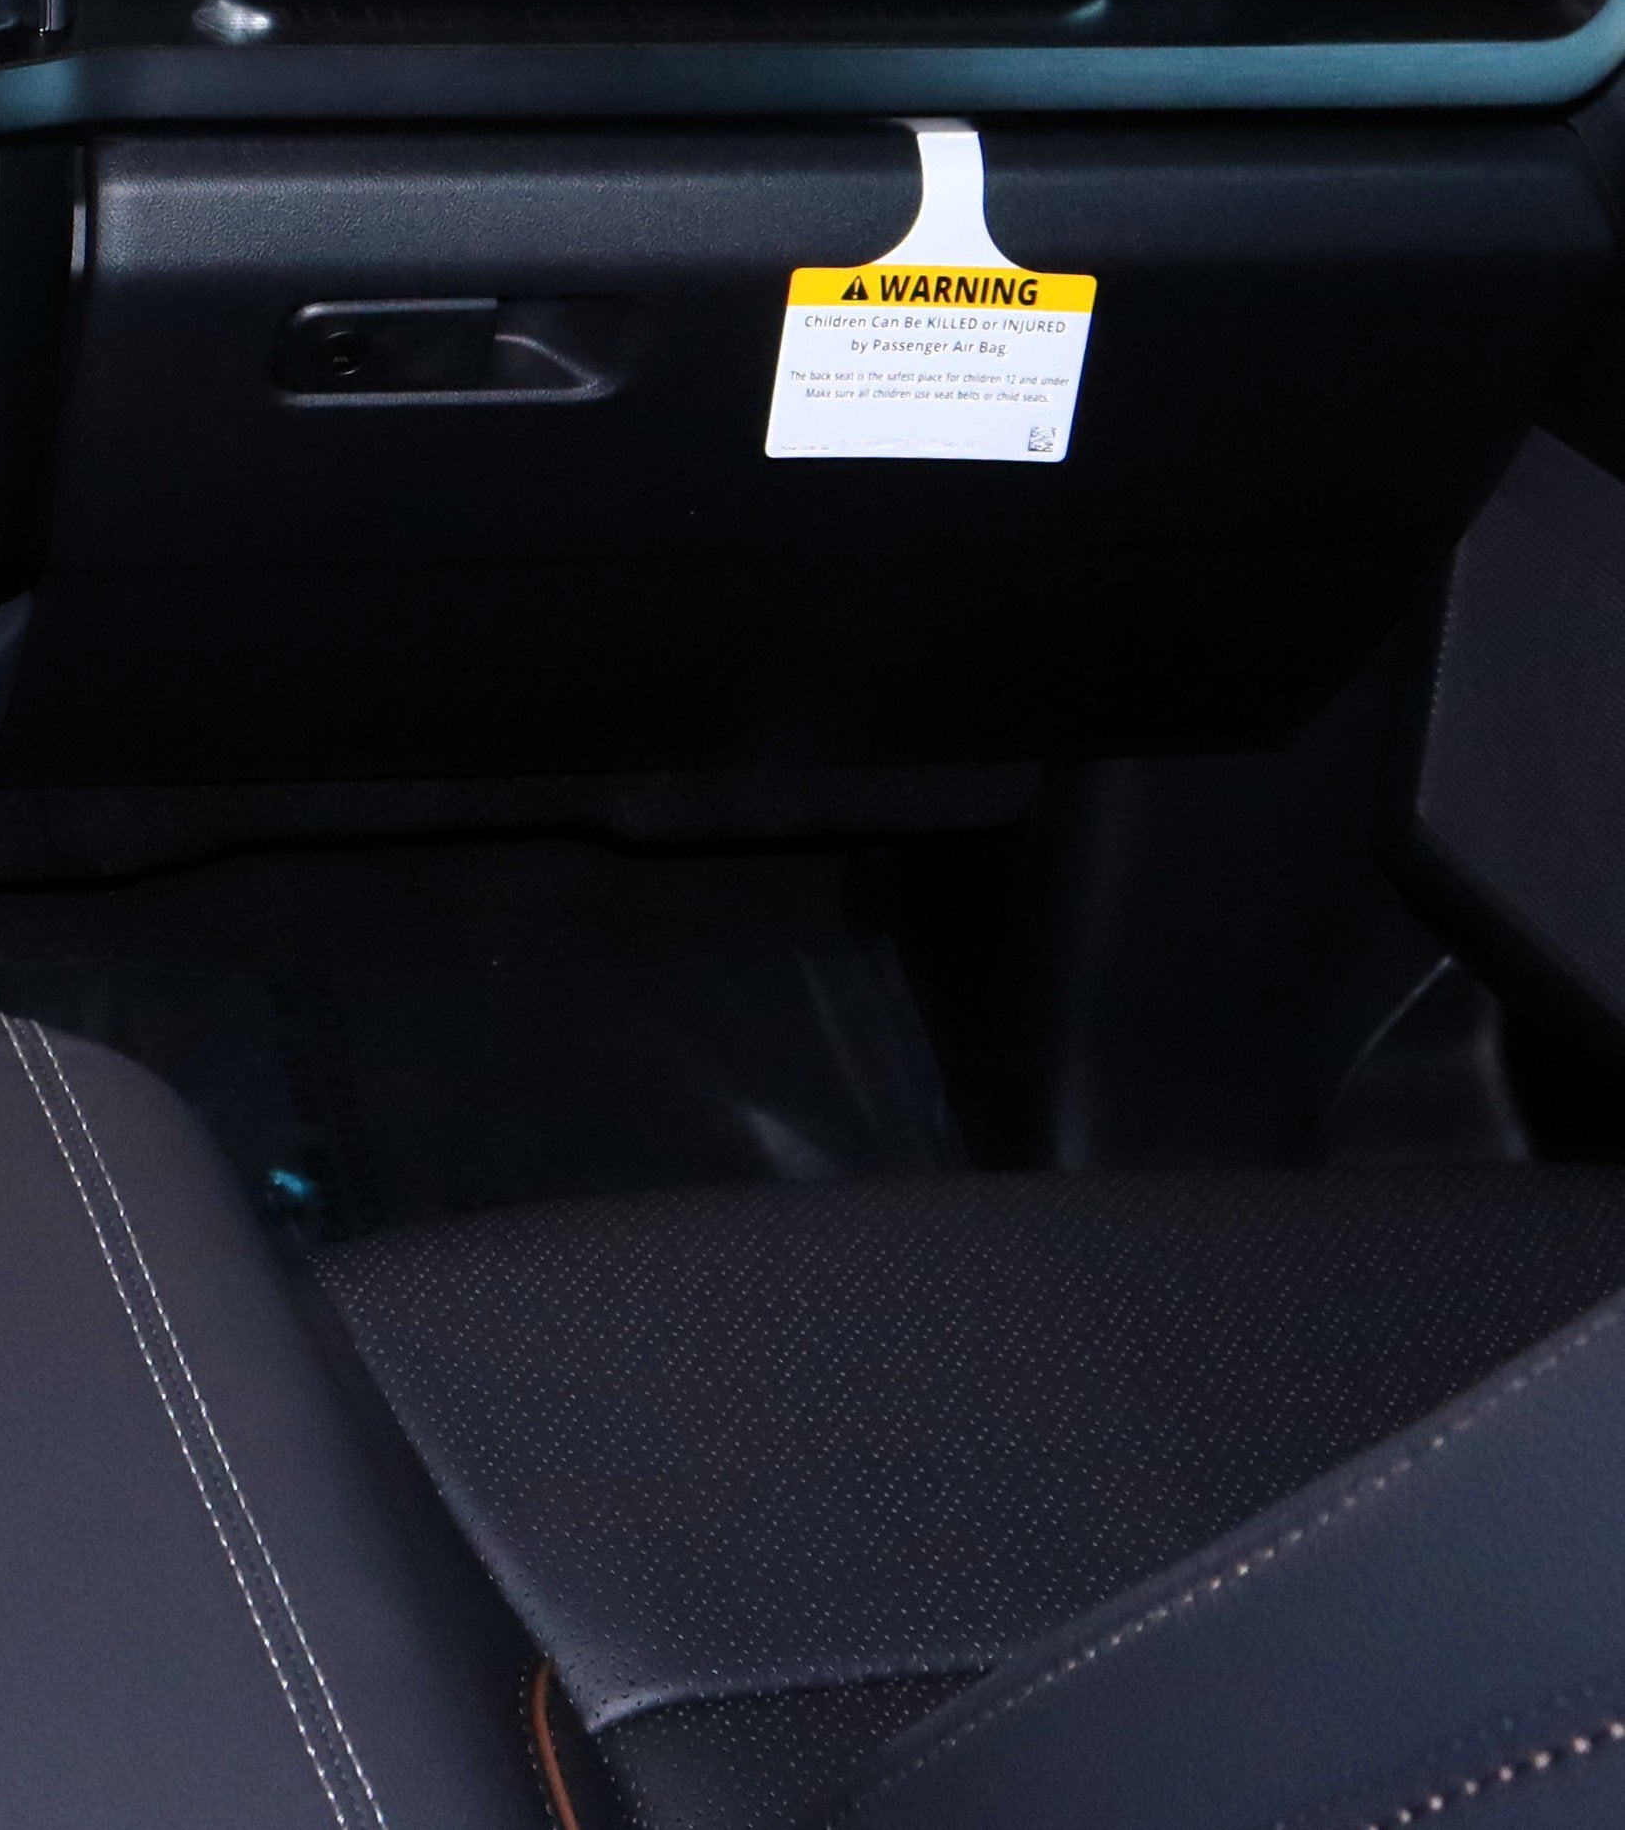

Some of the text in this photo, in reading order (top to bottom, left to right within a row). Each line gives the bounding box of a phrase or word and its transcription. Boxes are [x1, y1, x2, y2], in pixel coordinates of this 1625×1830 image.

[879, 274, 1039, 306] WARNING
[804, 315, 1067, 335] Children Can Be KILLED or INJURED
[851, 339, 868, 354] by
[873, 339, 948, 356] Passenger
[952, 341, 973, 353] Air
[791, 371, 806, 381] The
[834, 372, 855, 381] seat
[868, 372, 883, 381] the
[1019, 376, 1038, 385] and
[806, 388, 831, 398] Make
